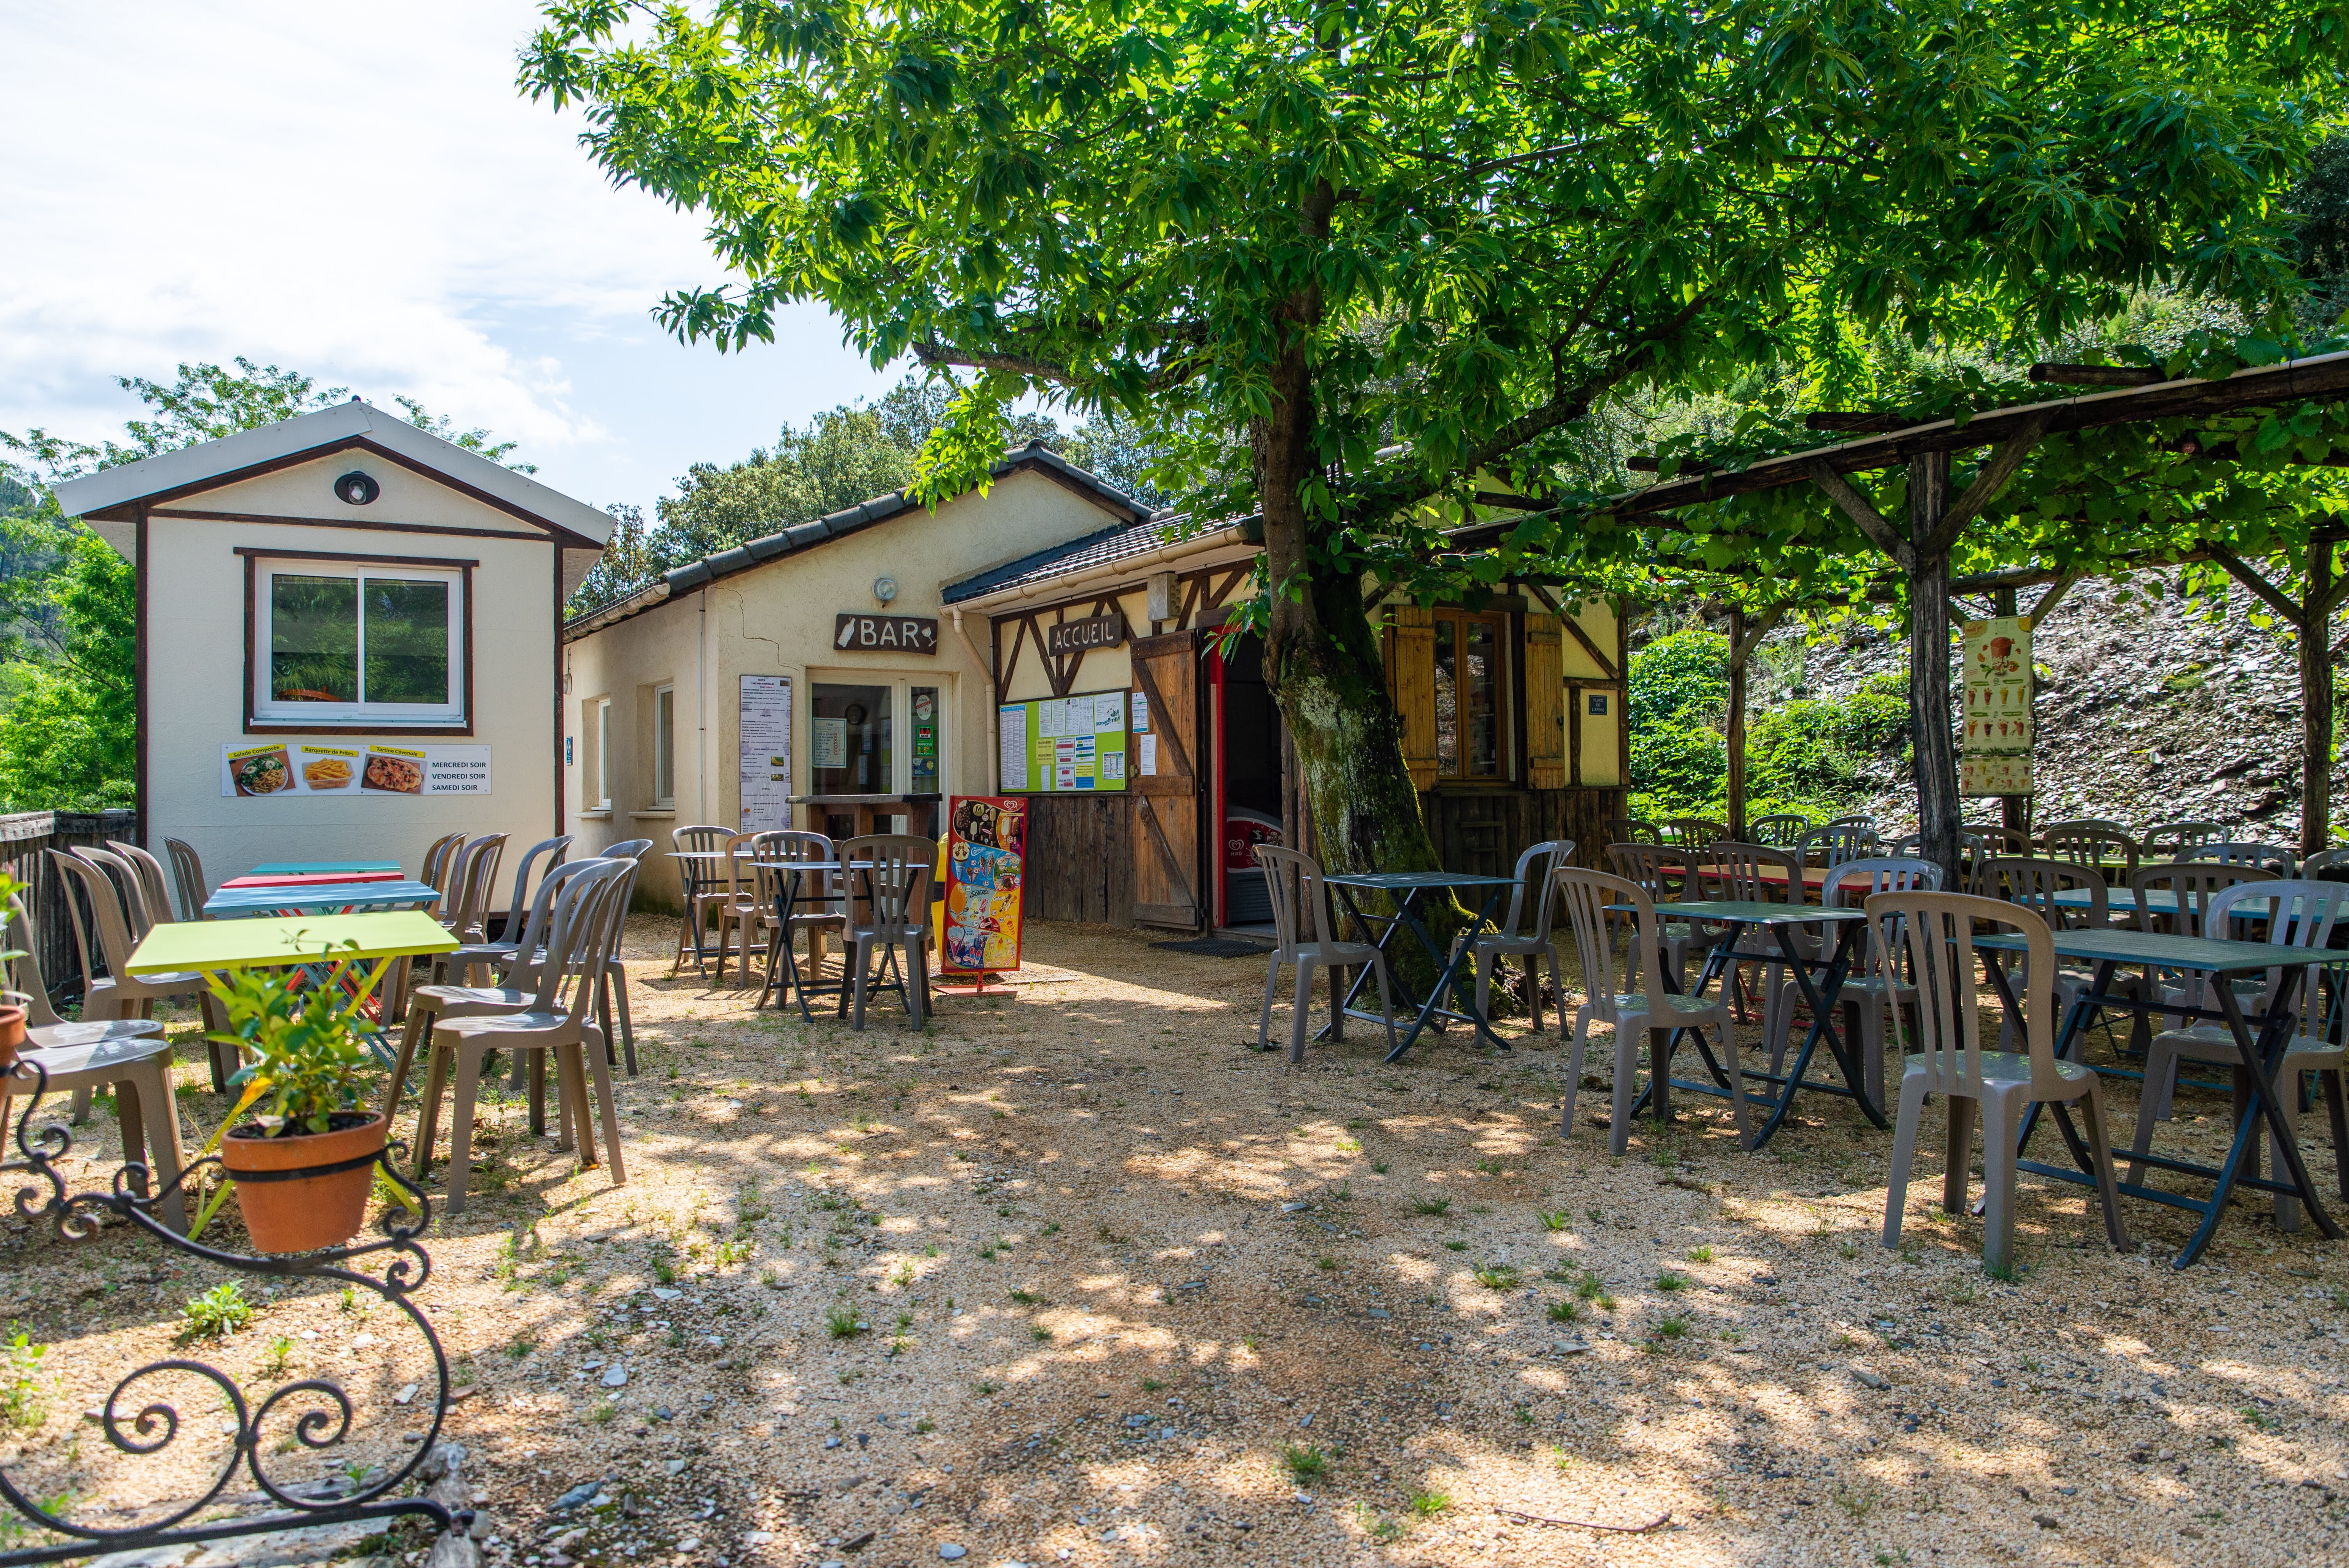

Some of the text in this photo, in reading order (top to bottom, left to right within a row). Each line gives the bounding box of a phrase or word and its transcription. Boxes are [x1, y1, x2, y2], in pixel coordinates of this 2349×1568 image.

[861, 619, 920, 647] BAR
[1055, 621, 1114, 649] ACCUEIL
[252, 745, 280, 754] Composée
